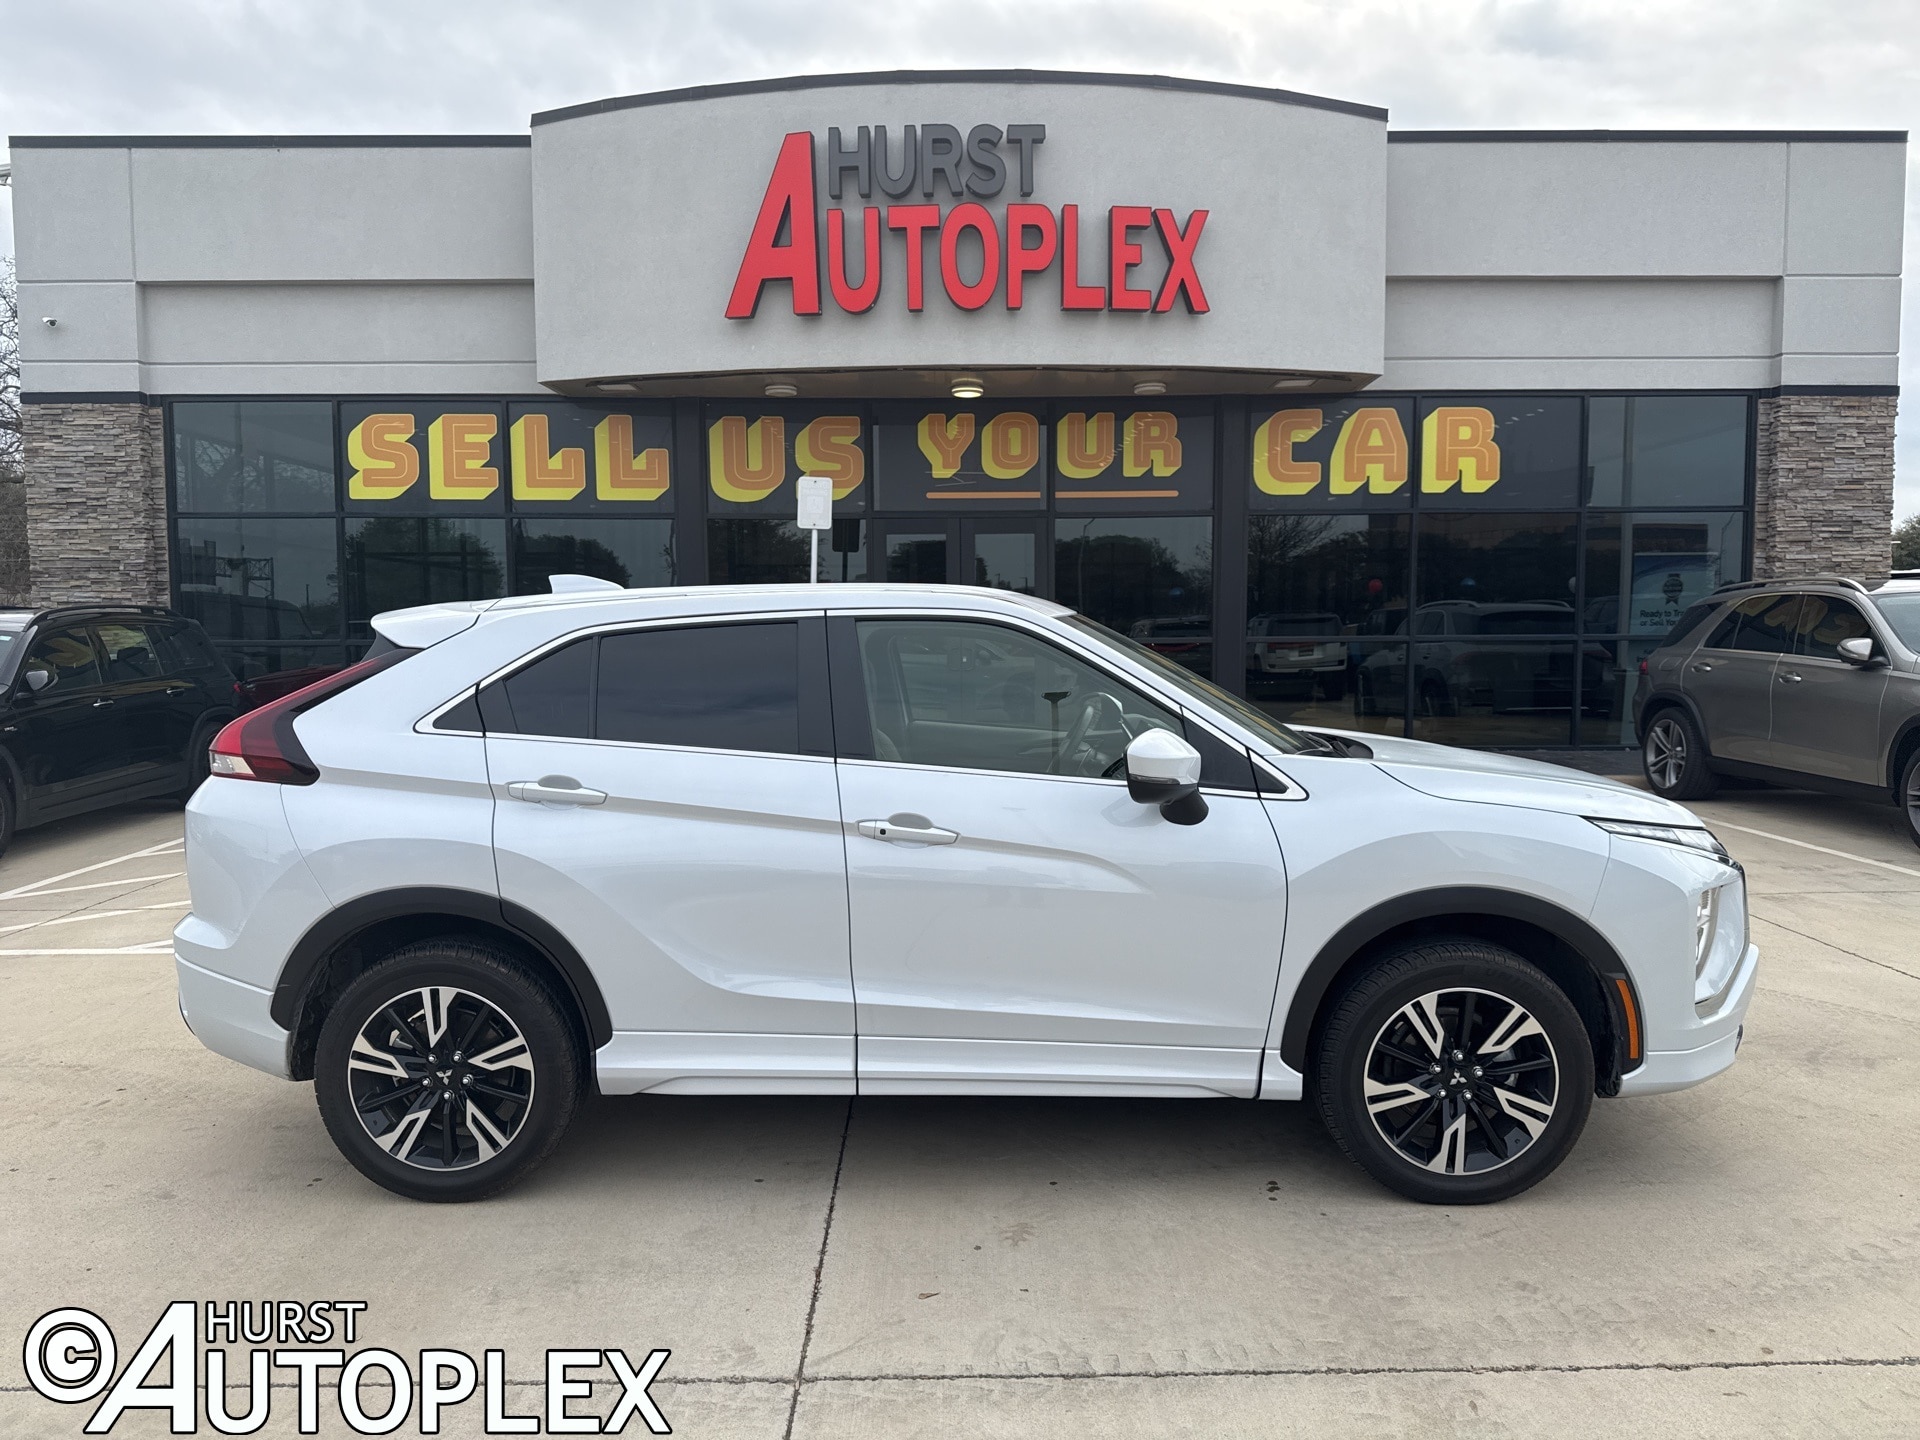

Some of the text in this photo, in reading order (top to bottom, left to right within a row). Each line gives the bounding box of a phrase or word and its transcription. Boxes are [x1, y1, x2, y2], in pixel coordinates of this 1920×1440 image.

[828, 123, 1046, 199] HURST
[725, 131, 1210, 320] AUTOPLEX
[347, 406, 1501, 503] SELL US YOUR CAR
[1640, 609, 1662, 619] Ready
[1664, 609, 1672, 617] to
[1649, 618, 1664, 627] Sell
